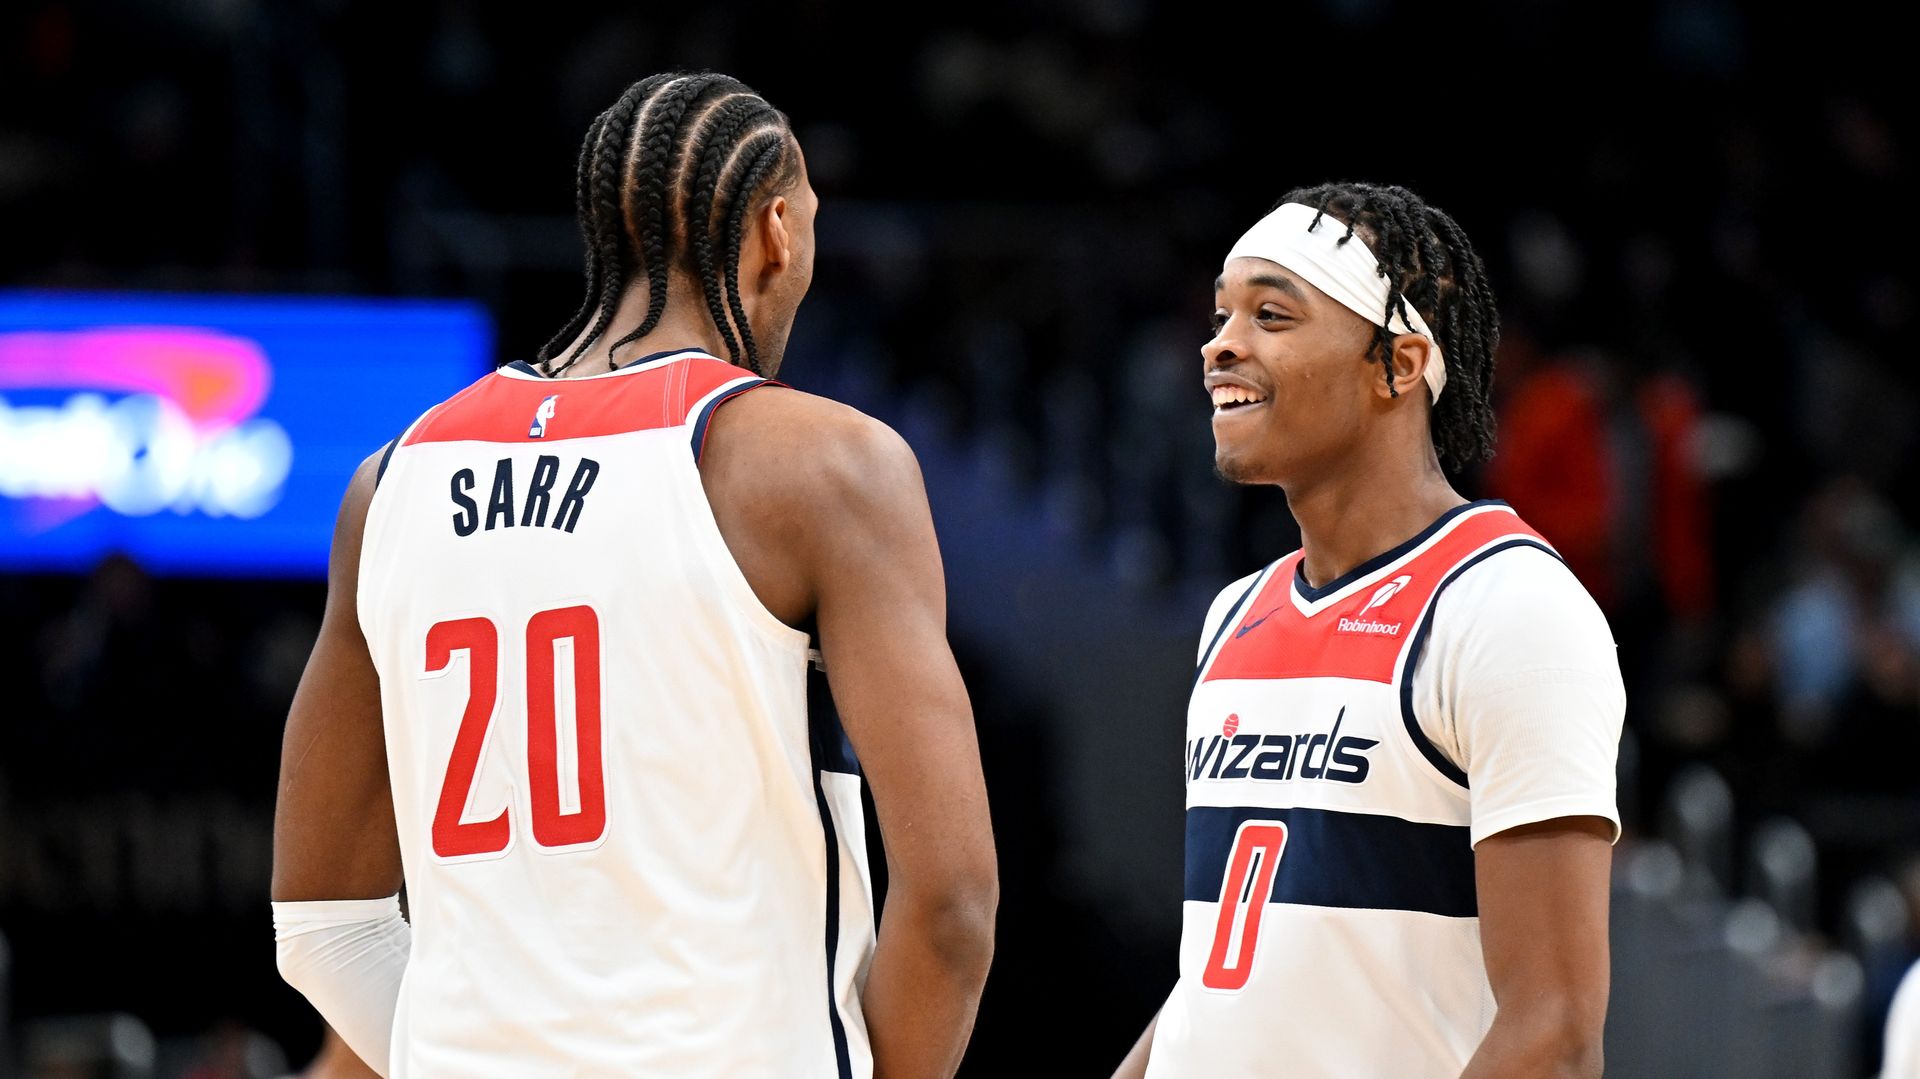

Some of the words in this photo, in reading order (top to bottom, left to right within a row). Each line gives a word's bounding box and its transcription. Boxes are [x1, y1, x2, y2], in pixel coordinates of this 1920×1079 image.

[450, 454, 600, 537] SARR
[1337, 617, 1401, 635] Robinhood
[423, 603, 607, 859] 20
[1187, 705, 1380, 784] wizards
[1202, 822, 1286, 991] 0
